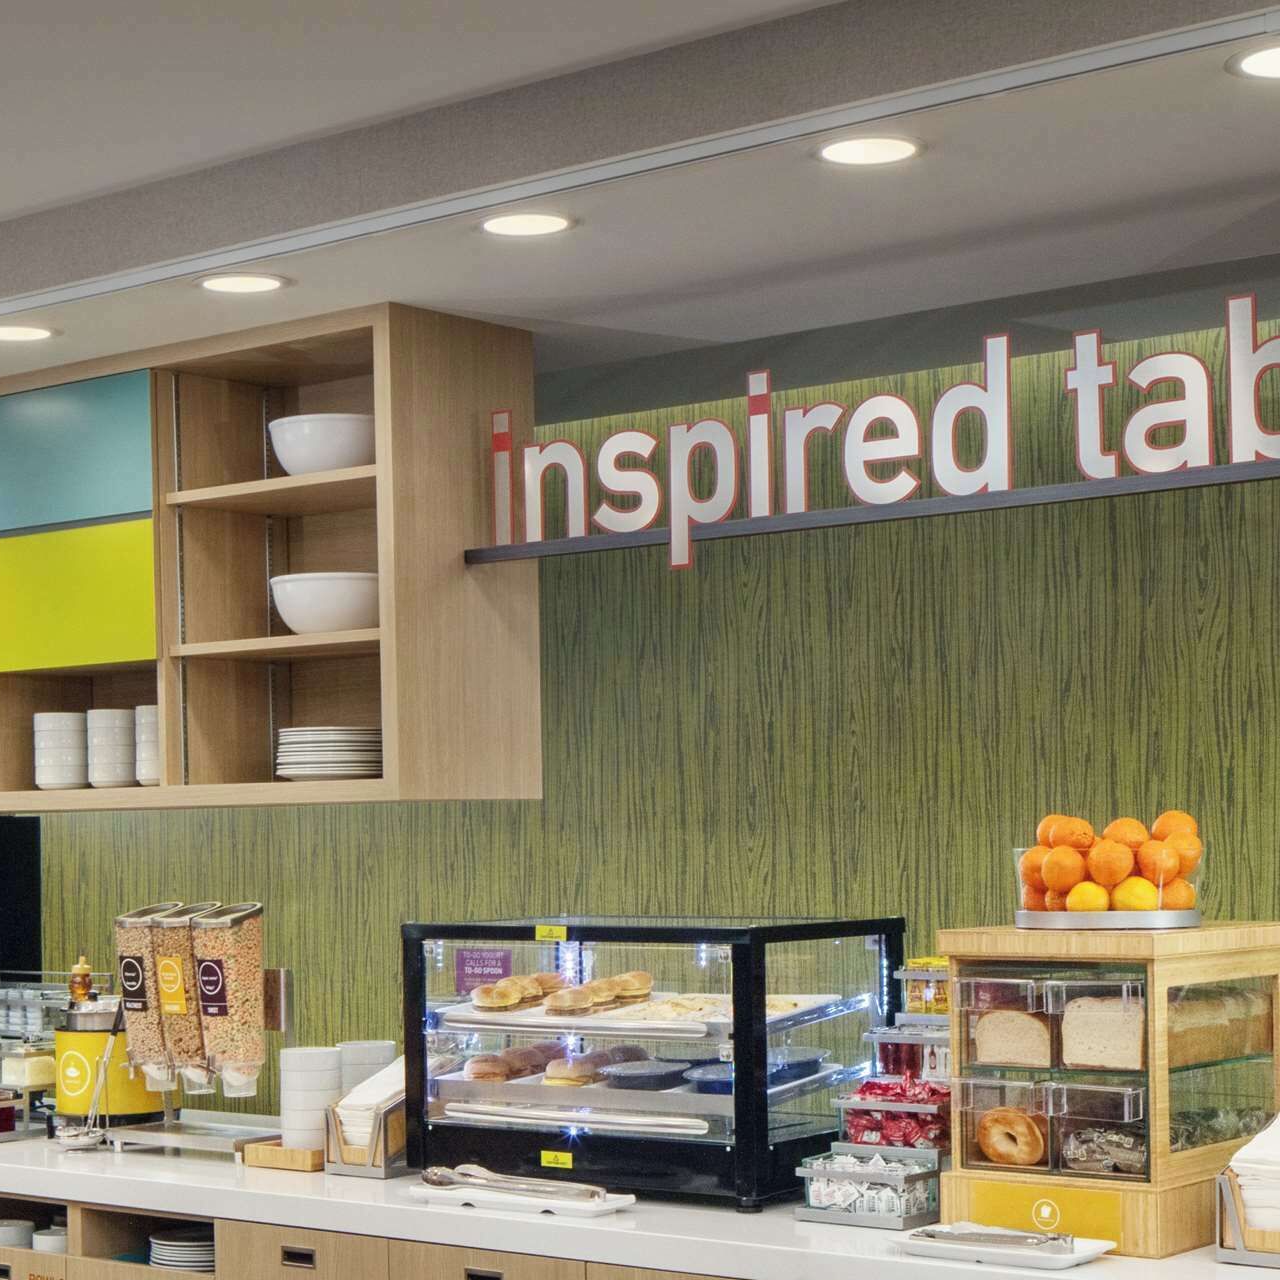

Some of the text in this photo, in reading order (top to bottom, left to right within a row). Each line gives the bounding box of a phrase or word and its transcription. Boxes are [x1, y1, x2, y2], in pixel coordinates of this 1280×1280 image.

[491, 333, 1013, 569] inspired
[463, 951, 504, 960] TO-GO YOGURT
[465, 959, 484, 967] CALLS
[485, 959, 496, 967] FOR
[464, 966, 503, 975] TO-GO SPOON
